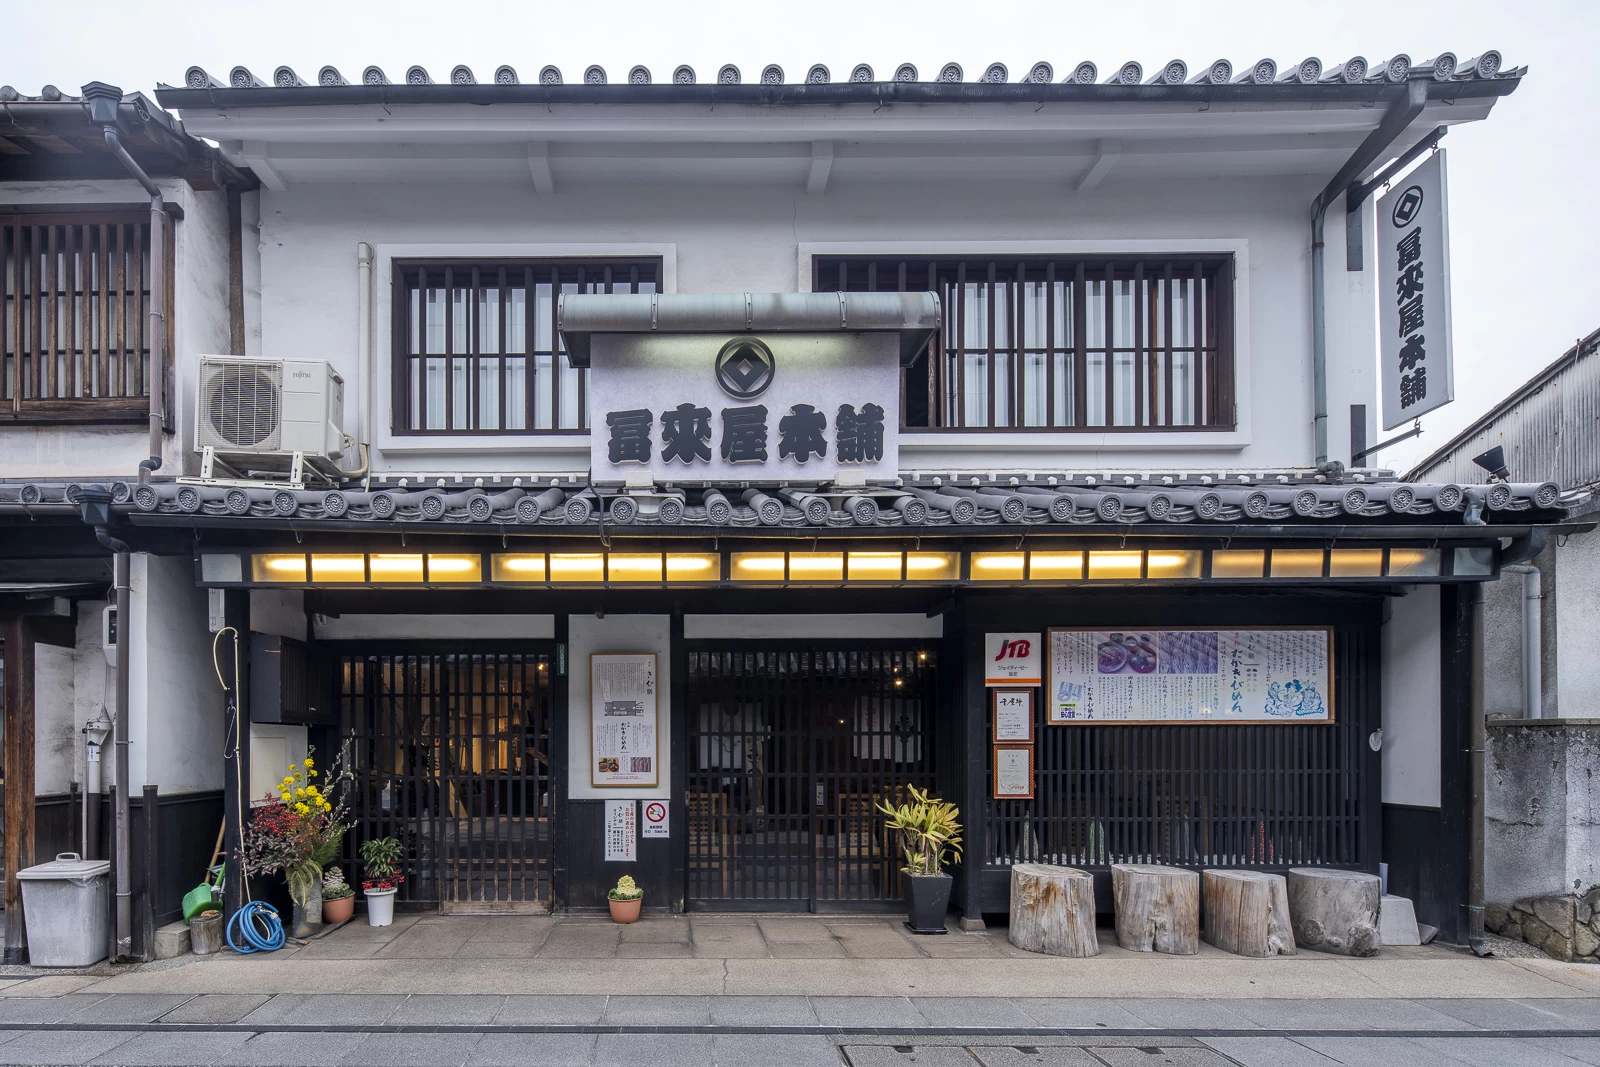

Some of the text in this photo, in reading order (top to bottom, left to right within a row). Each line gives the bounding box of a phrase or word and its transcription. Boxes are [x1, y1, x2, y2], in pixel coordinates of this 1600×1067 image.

[994, 639, 1031, 661] JTB
[1230, 649, 1244, 713] たかきびめん
